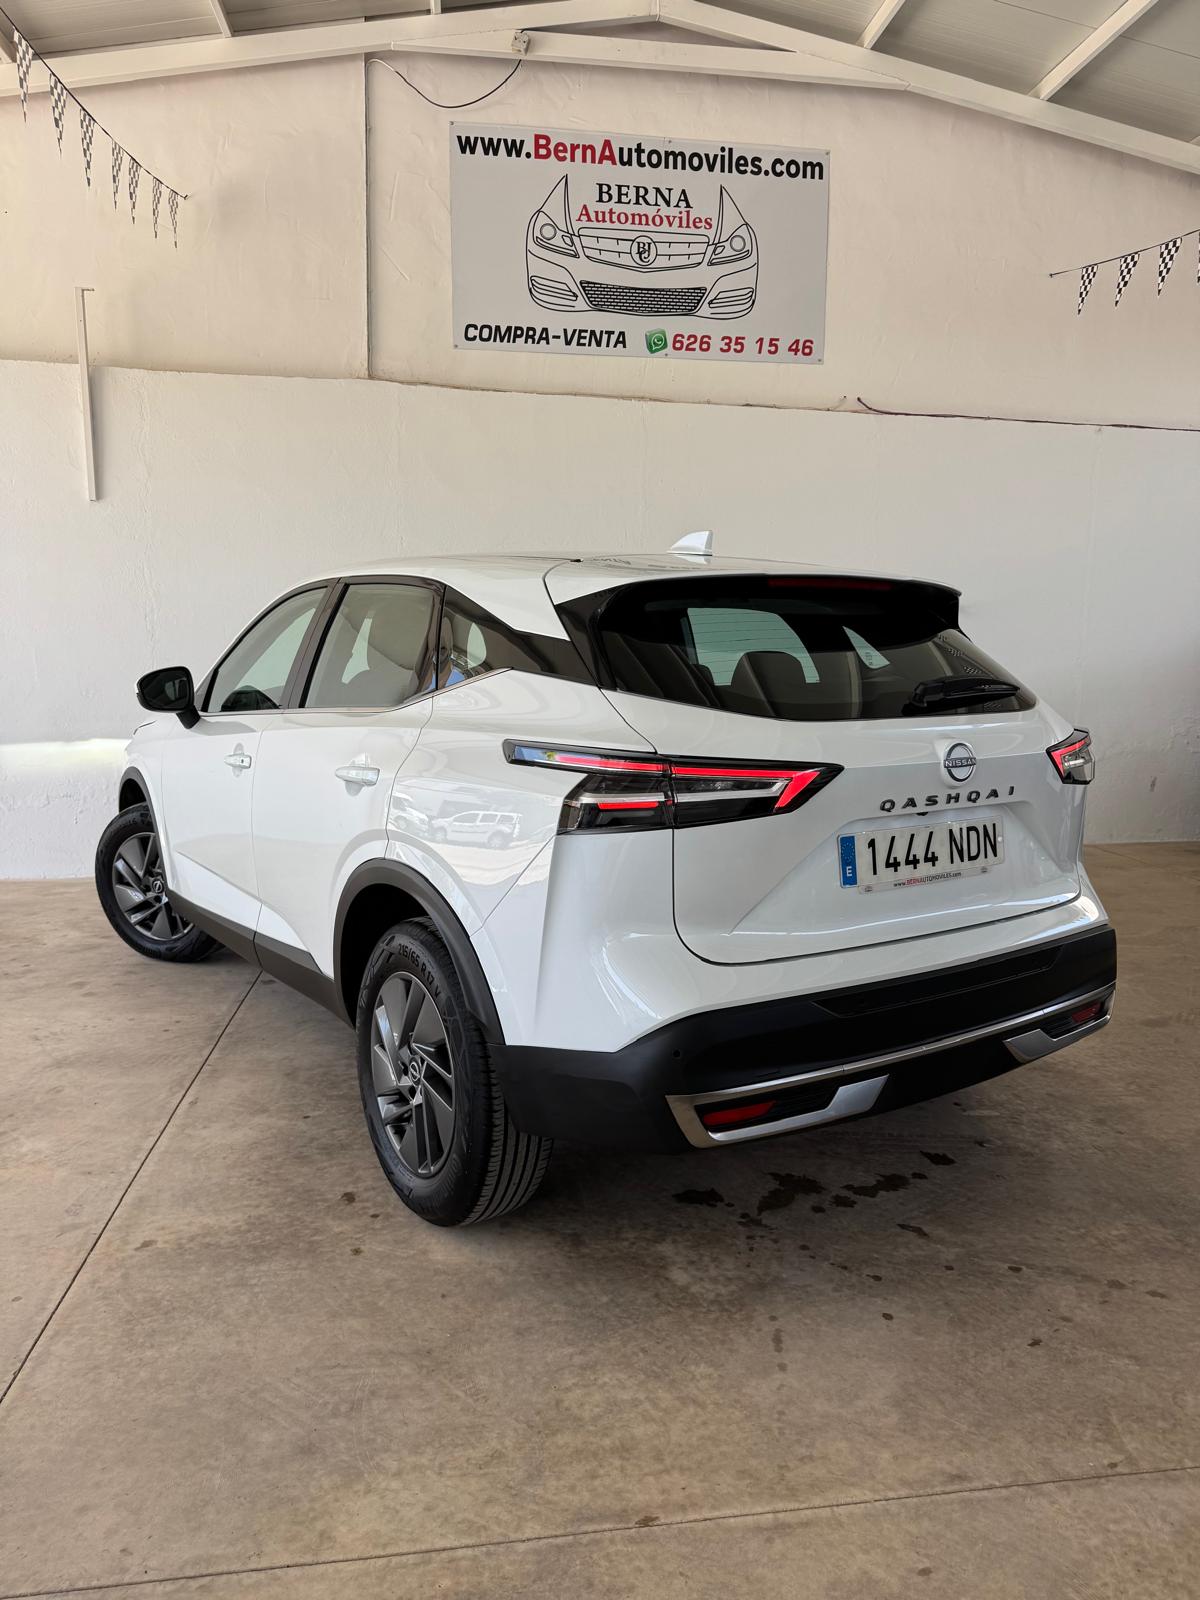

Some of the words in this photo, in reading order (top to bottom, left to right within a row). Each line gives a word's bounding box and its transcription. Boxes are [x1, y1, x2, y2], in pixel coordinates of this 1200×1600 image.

[456, 133, 824, 180] www.BernAutomoviles.com
[596, 182, 693, 209] BERNA
[575, 204, 713, 230] Automóviles
[464, 323, 627, 349] COMPRA-VENTA
[672, 333, 711, 352] 626
[719, 335, 745, 354] 35
[754, 337, 779, 355] 15
[788, 338, 814, 356] 46
[945, 758, 976, 767] NISSAN
[879, 786, 1015, 812] QASHQAI
[867, 831, 939, 875] 1444
[949, 823, 998, 864] NDN
[846, 865, 853, 877] E
